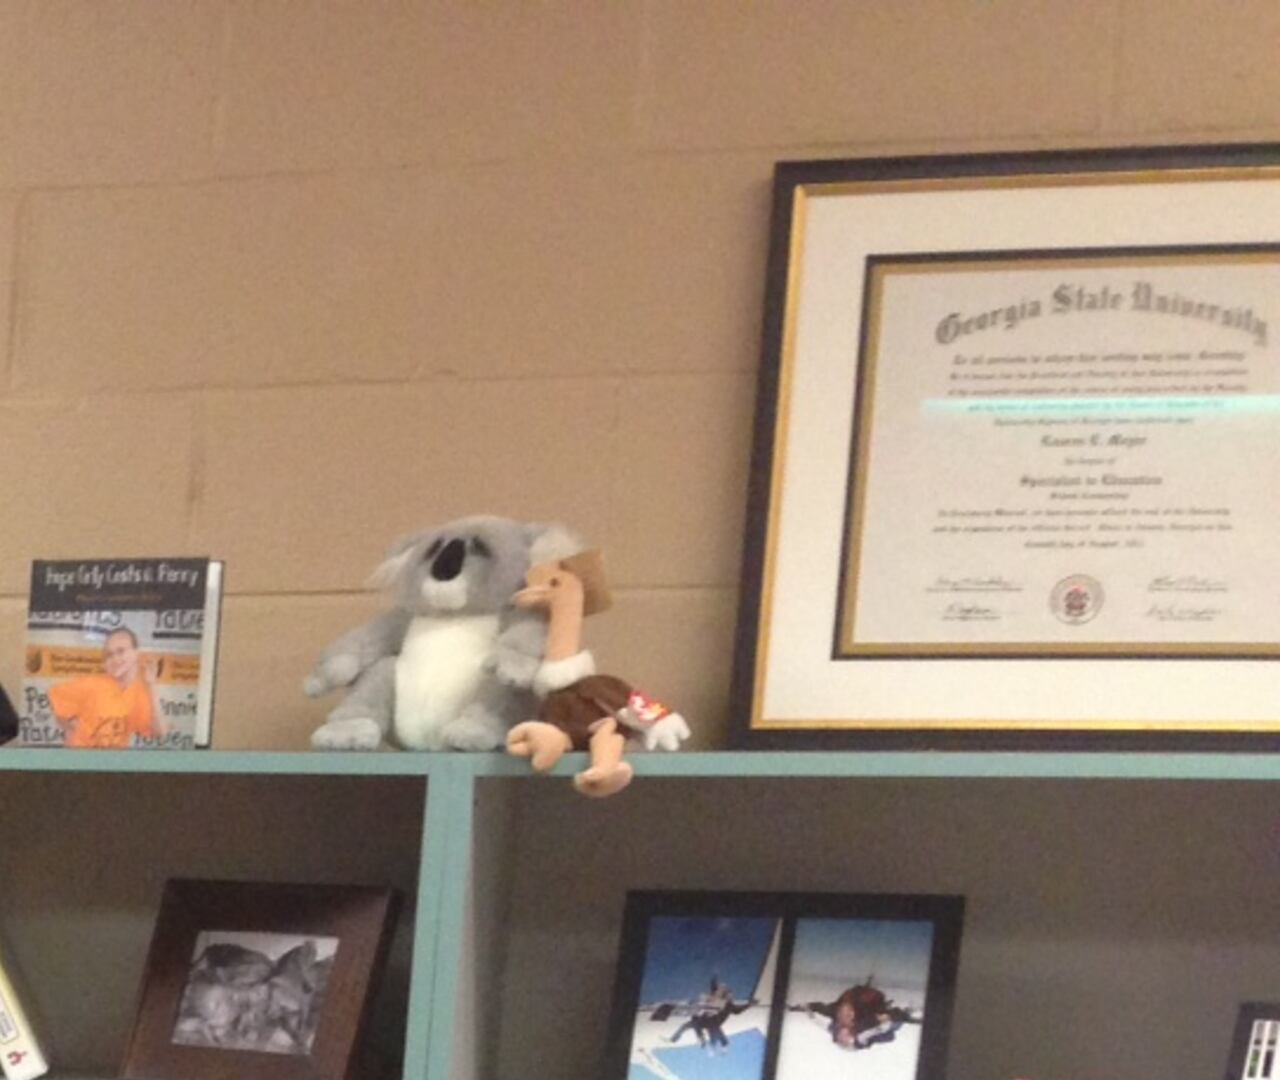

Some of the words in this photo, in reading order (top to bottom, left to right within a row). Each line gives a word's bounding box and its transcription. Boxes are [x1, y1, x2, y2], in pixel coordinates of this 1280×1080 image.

[935, 300, 1041, 344] Georgia
[1051, 283, 1123, 314] State
[1130, 281, 1268, 348] University
